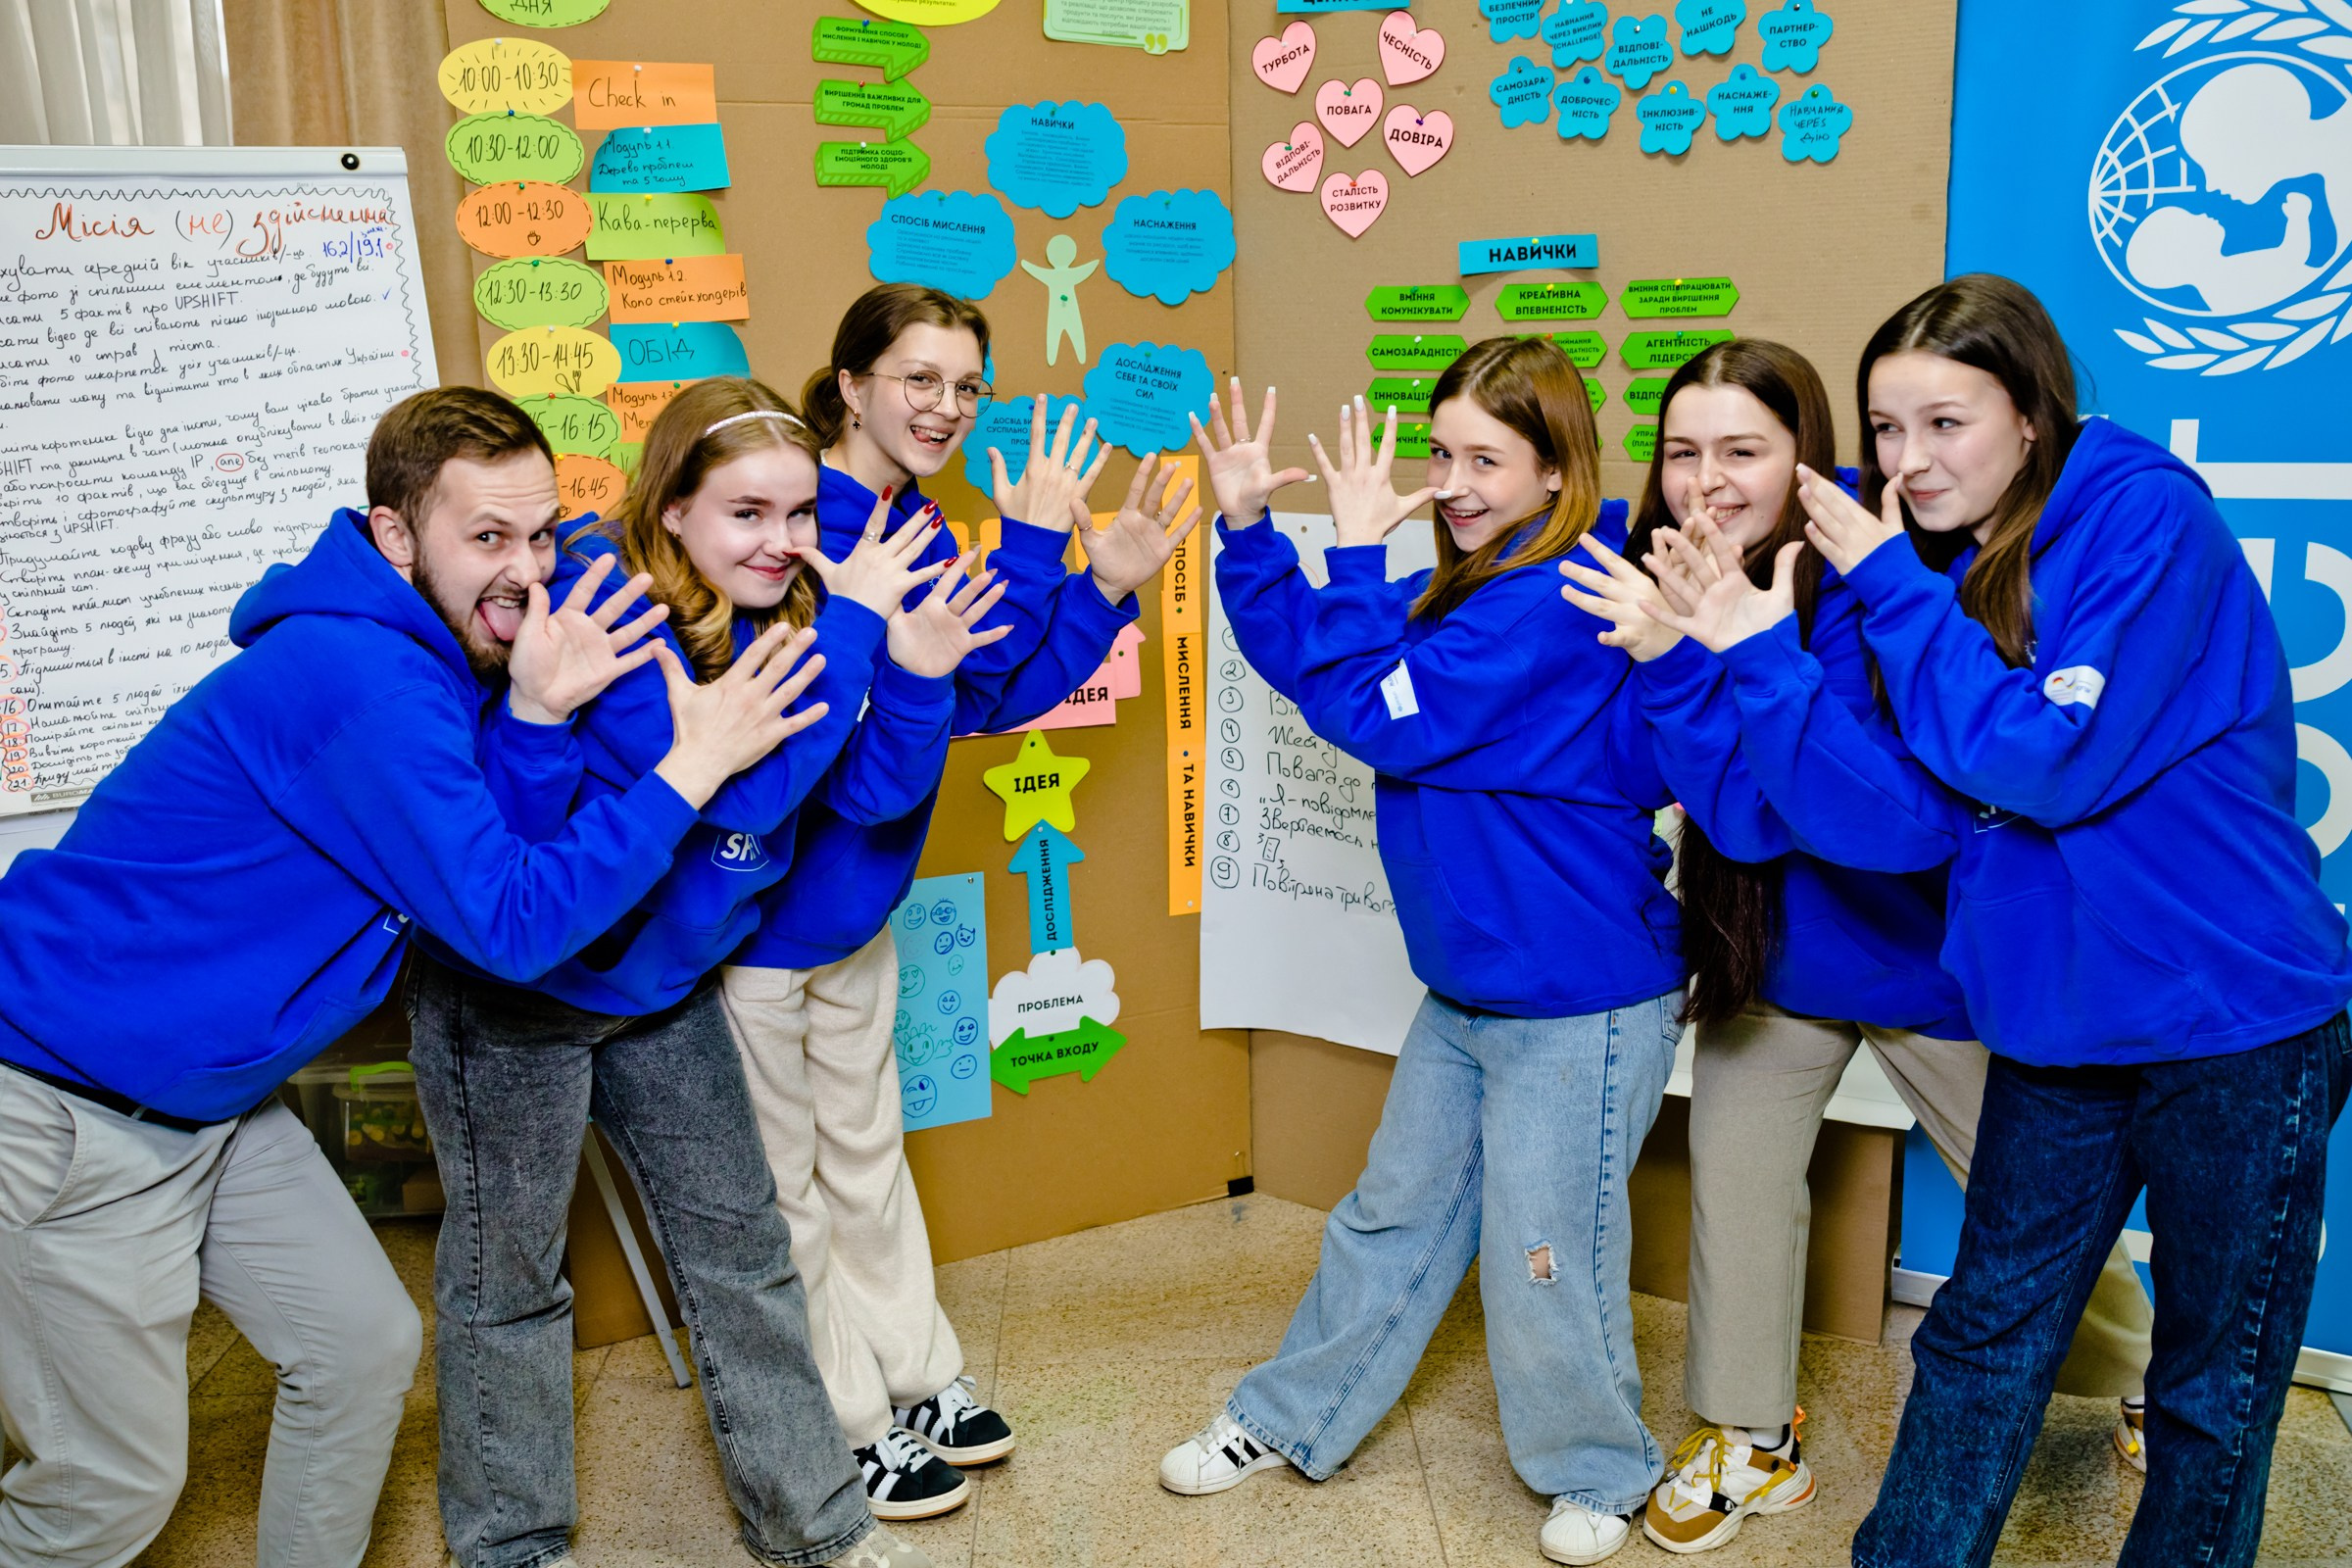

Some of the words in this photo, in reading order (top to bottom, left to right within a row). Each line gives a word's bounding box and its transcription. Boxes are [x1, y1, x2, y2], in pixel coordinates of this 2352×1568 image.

[1489, 0, 1541, 13] БЕЗПЕЧНИЙ
[1701, 7, 1714, 18] НЕ
[1495, 13, 1536, 24] ПРОСТІР
[1686, 14, 1738, 37] НАШКОДЬ
[822, 33, 857, 42] МИСЛЕННЯ
[836, 26, 878, 35] ФОРМУВАННЯ
[1549, 29, 1571, 40] ЧЕРЕЗ
[1572, 22, 1602, 35] ВИКЛИК
[1769, 23, 1819, 34] ПАРТНЕР-
[1553, 31, 1601, 51] (CHALLENGE)
[1618, 42, 1663, 53] ВІДПОВІ-
[1780, 39, 1807, 48] СТВО
[1262, 44, 1310, 74] ТУРБОТА
[1383, 31, 1432, 71] ЧЕСНІСТЬ
[1613, 55, 1668, 69] ДАЛЬНІСТЬ
[588, 77, 647, 109] Check
[662, 92, 676, 107] in
[1495, 76, 1548, 93] САМОЗАРА-
[825, 89, 865, 99] ВИРІШЕННЯ
[866, 93, 906, 103] ВАЖЛИВИХ
[1507, 91, 1542, 105] ДНІСТЬ
[1560, 96, 1614, 107] ДОБРОЧЕС-
[1718, 90, 1773, 101] НАСНАЖЕ-
[842, 101, 870, 110] ГРОМАД
[871, 103, 905, 112] ПРОБЛЕМ
[1326, 105, 1372, 116] ПОВАГА
[1642, 109, 1698, 119] ІНКЛЮЗИВ-
[1031, 117, 1074, 129] НАВИЧКИ
[1655, 122, 1684, 131] НІСТЬ
[603, 133, 652, 159] Модуль
[1390, 128, 1444, 148] ДОВІРА
[1275, 140, 1311, 170] ВІДПОВІ-
[599, 161, 639, 175] Дерево
[643, 157, 694, 173] проблем
[1277, 149, 1321, 184] ДАЛЬНІСТЬ
[622, 176, 638, 185] та
[644, 176, 651, 185] 5
[655, 175, 686, 187] чому
[1332, 186, 1379, 198] СТАЛІСТЬ
[1330, 200, 1382, 213] РОЗВИТКУ
[35, 203, 155, 242] Місія
[175, 209, 233, 250] (не)
[236, 202, 394, 258] здійсненна
[891, 214, 929, 227] СПОСІБ
[932, 220, 986, 234] МИСЛЕННЯ
[1133, 219, 1197, 230] НАСНАЖЕННЯ
[1489, 243, 1577, 264] НАВИЧКИ
[85, 258, 159, 283] середній
[172, 253, 194, 270] вік
[612, 265, 664, 289] Модуль
[18, 289, 59, 305] фото
[292, 272, 308, 294] де
[307, 264, 350, 288] будуть
[1660, 283, 1731, 292] СПІВПРАЦЮВАТИ
[622, 292, 653, 309] Коло
[1399, 293, 1435, 302] ВМІННЯ
[1519, 290, 1581, 300] КРЕАТИВНА
[1672, 294, 1720, 303] ВИРІШЕННЯ
[61, 309, 69, 319] 5
[75, 302, 132, 321] фактів
[143, 304, 169, 319] про
[1381, 306, 1453, 315] КОМУНІКУВАТИ
[1515, 305, 1588, 316] ВПЕВНЕНІСТЬ
[48, 327, 76, 349] відео
[84, 329, 98, 348] де
[110, 321, 124, 335] всі
[134, 318, 200, 334] співають
[629, 337, 695, 366] ОБІД
[1646, 338, 1711, 348] АГЕНТНІСТЬ
[69, 354, 81, 366] 10
[96, 343, 138, 364] страв
[38, 372, 74, 386] фото
[85, 367, 169, 383] шкарпеток
[179, 361, 201, 379] усіх
[1115, 357, 1182, 379] ДОСЛІДЖЕННЯ
[70, 393, 106, 409] мапу
[144, 380, 210, 403] відмітити
[218, 376, 239, 386] хто
[244, 368, 249, 380] в
[259, 369, 283, 380] яких
[287, 359, 342, 374] областях
[345, 347, 395, 365] України
[1115, 370, 1137, 384] СЕБЕ
[1138, 375, 1149, 385] ТА
[1151, 377, 1179, 391] СВОЇХ
[612, 387, 658, 408] Модуль
[1135, 389, 1154, 400] СИЛ
[124, 424, 153, 445] відео
[297, 393, 333, 411] цікаво
[340, 387, 378, 403] брати
[993, 416, 1022, 426] ДОСВІД
[986, 426, 1028, 435] СУСПІЛЬНО
[122, 466, 186, 481] команду
[1174, 536, 1187, 603] СПОСІБ
[1177, 636, 1192, 729] МИСЛЕННЯ
[27, 696, 102, 712] Опитайте
[126, 684, 163, 706] людей
[1064, 687, 1108, 706] ІДЕЯ
[1013, 772, 1060, 794] ІДЕЯ
[1183, 763, 1195, 785] ТА
[1267, 752, 1337, 784] Повага
[1339, 776, 1361, 803] до
[52, 787, 94, 798] BUROMA
[1183, 789, 1196, 867] НАВИЧКИ
[1041, 838, 1057, 941] ДОСЛІДЖЕННЯ
[1017, 993, 1084, 1014] ПРОБЛЕМА
[1010, 1048, 1054, 1069] ТОЧКА
[1056, 1040, 1100, 1062] ВХОДУ
